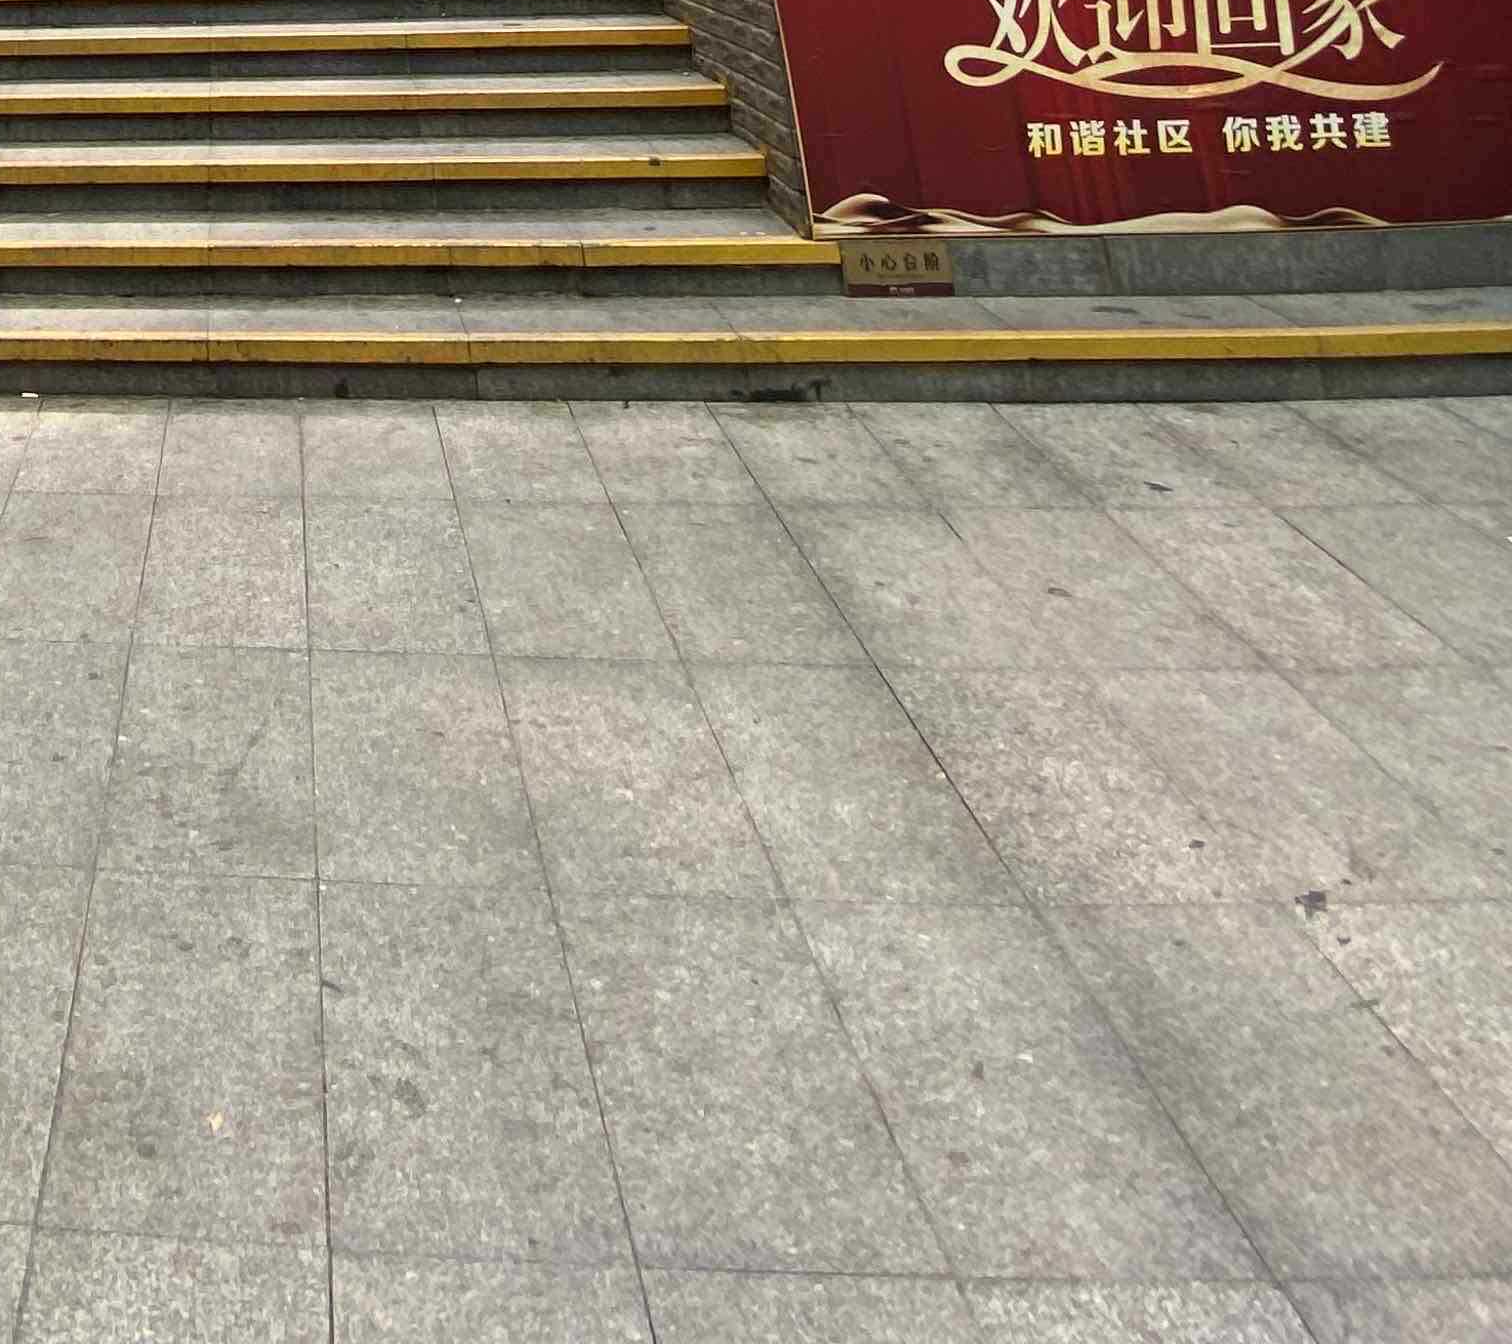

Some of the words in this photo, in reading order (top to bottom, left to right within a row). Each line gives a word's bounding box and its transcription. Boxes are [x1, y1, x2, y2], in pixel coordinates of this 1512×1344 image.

[1028, 118, 1194, 158] 和谐社区
[1223, 111, 1392, 152] 你我共建
